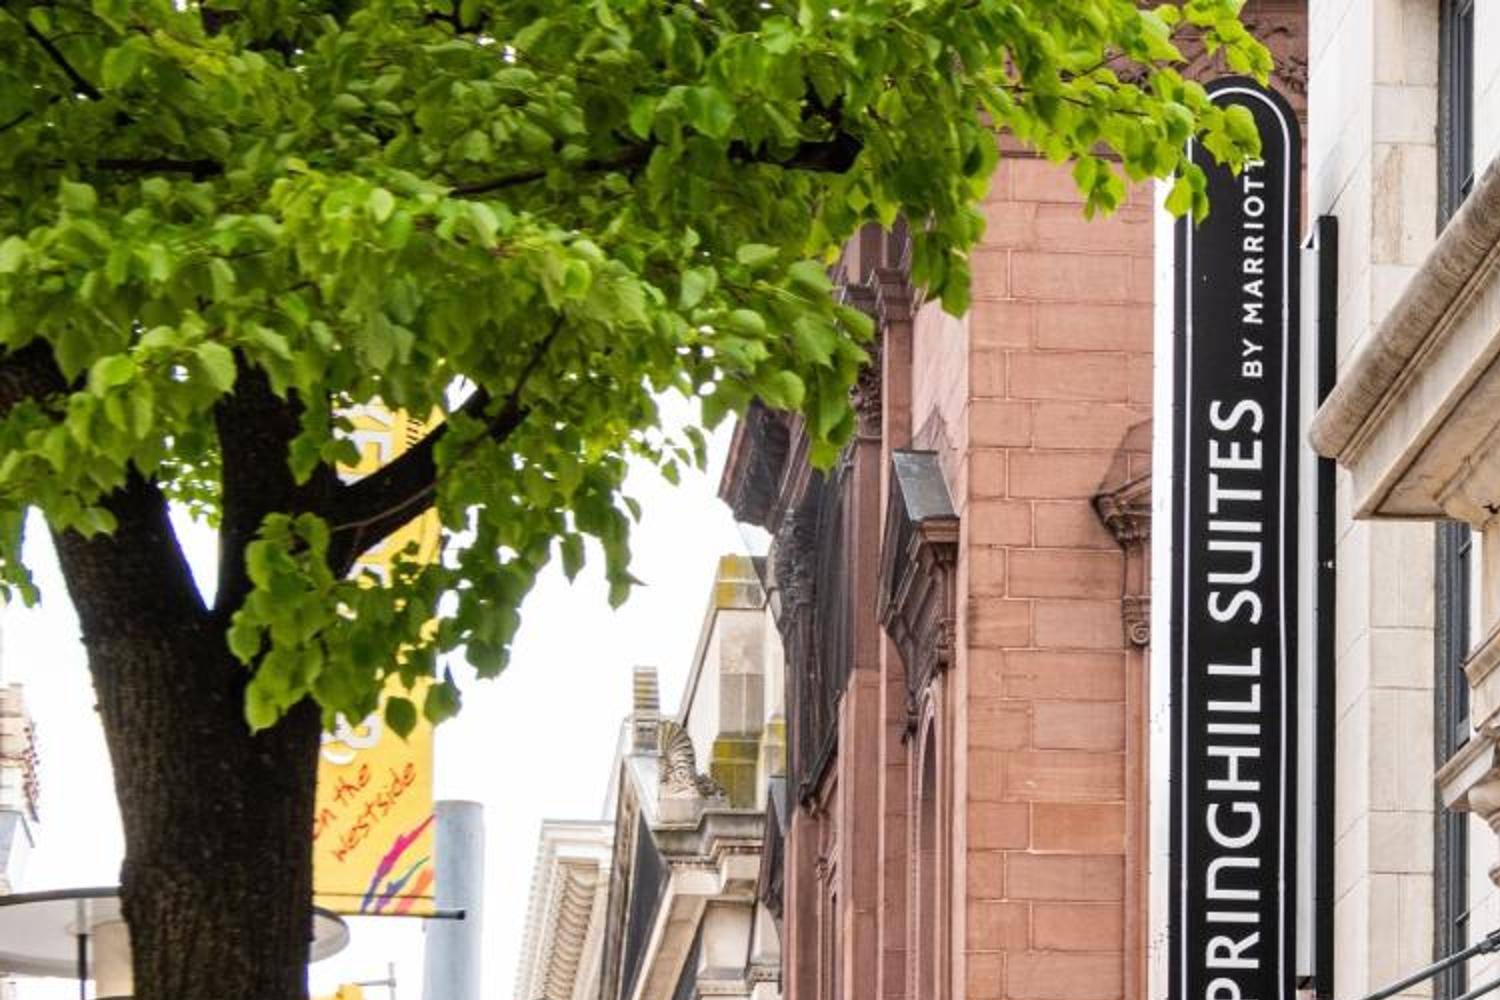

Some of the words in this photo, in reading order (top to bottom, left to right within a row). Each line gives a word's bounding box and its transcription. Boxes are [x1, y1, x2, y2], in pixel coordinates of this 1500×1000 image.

[1243, 155, 1266, 324] MARRIOTT
[1242, 338, 1264, 379] BY
[1207, 399, 1264, 625] SUITES
